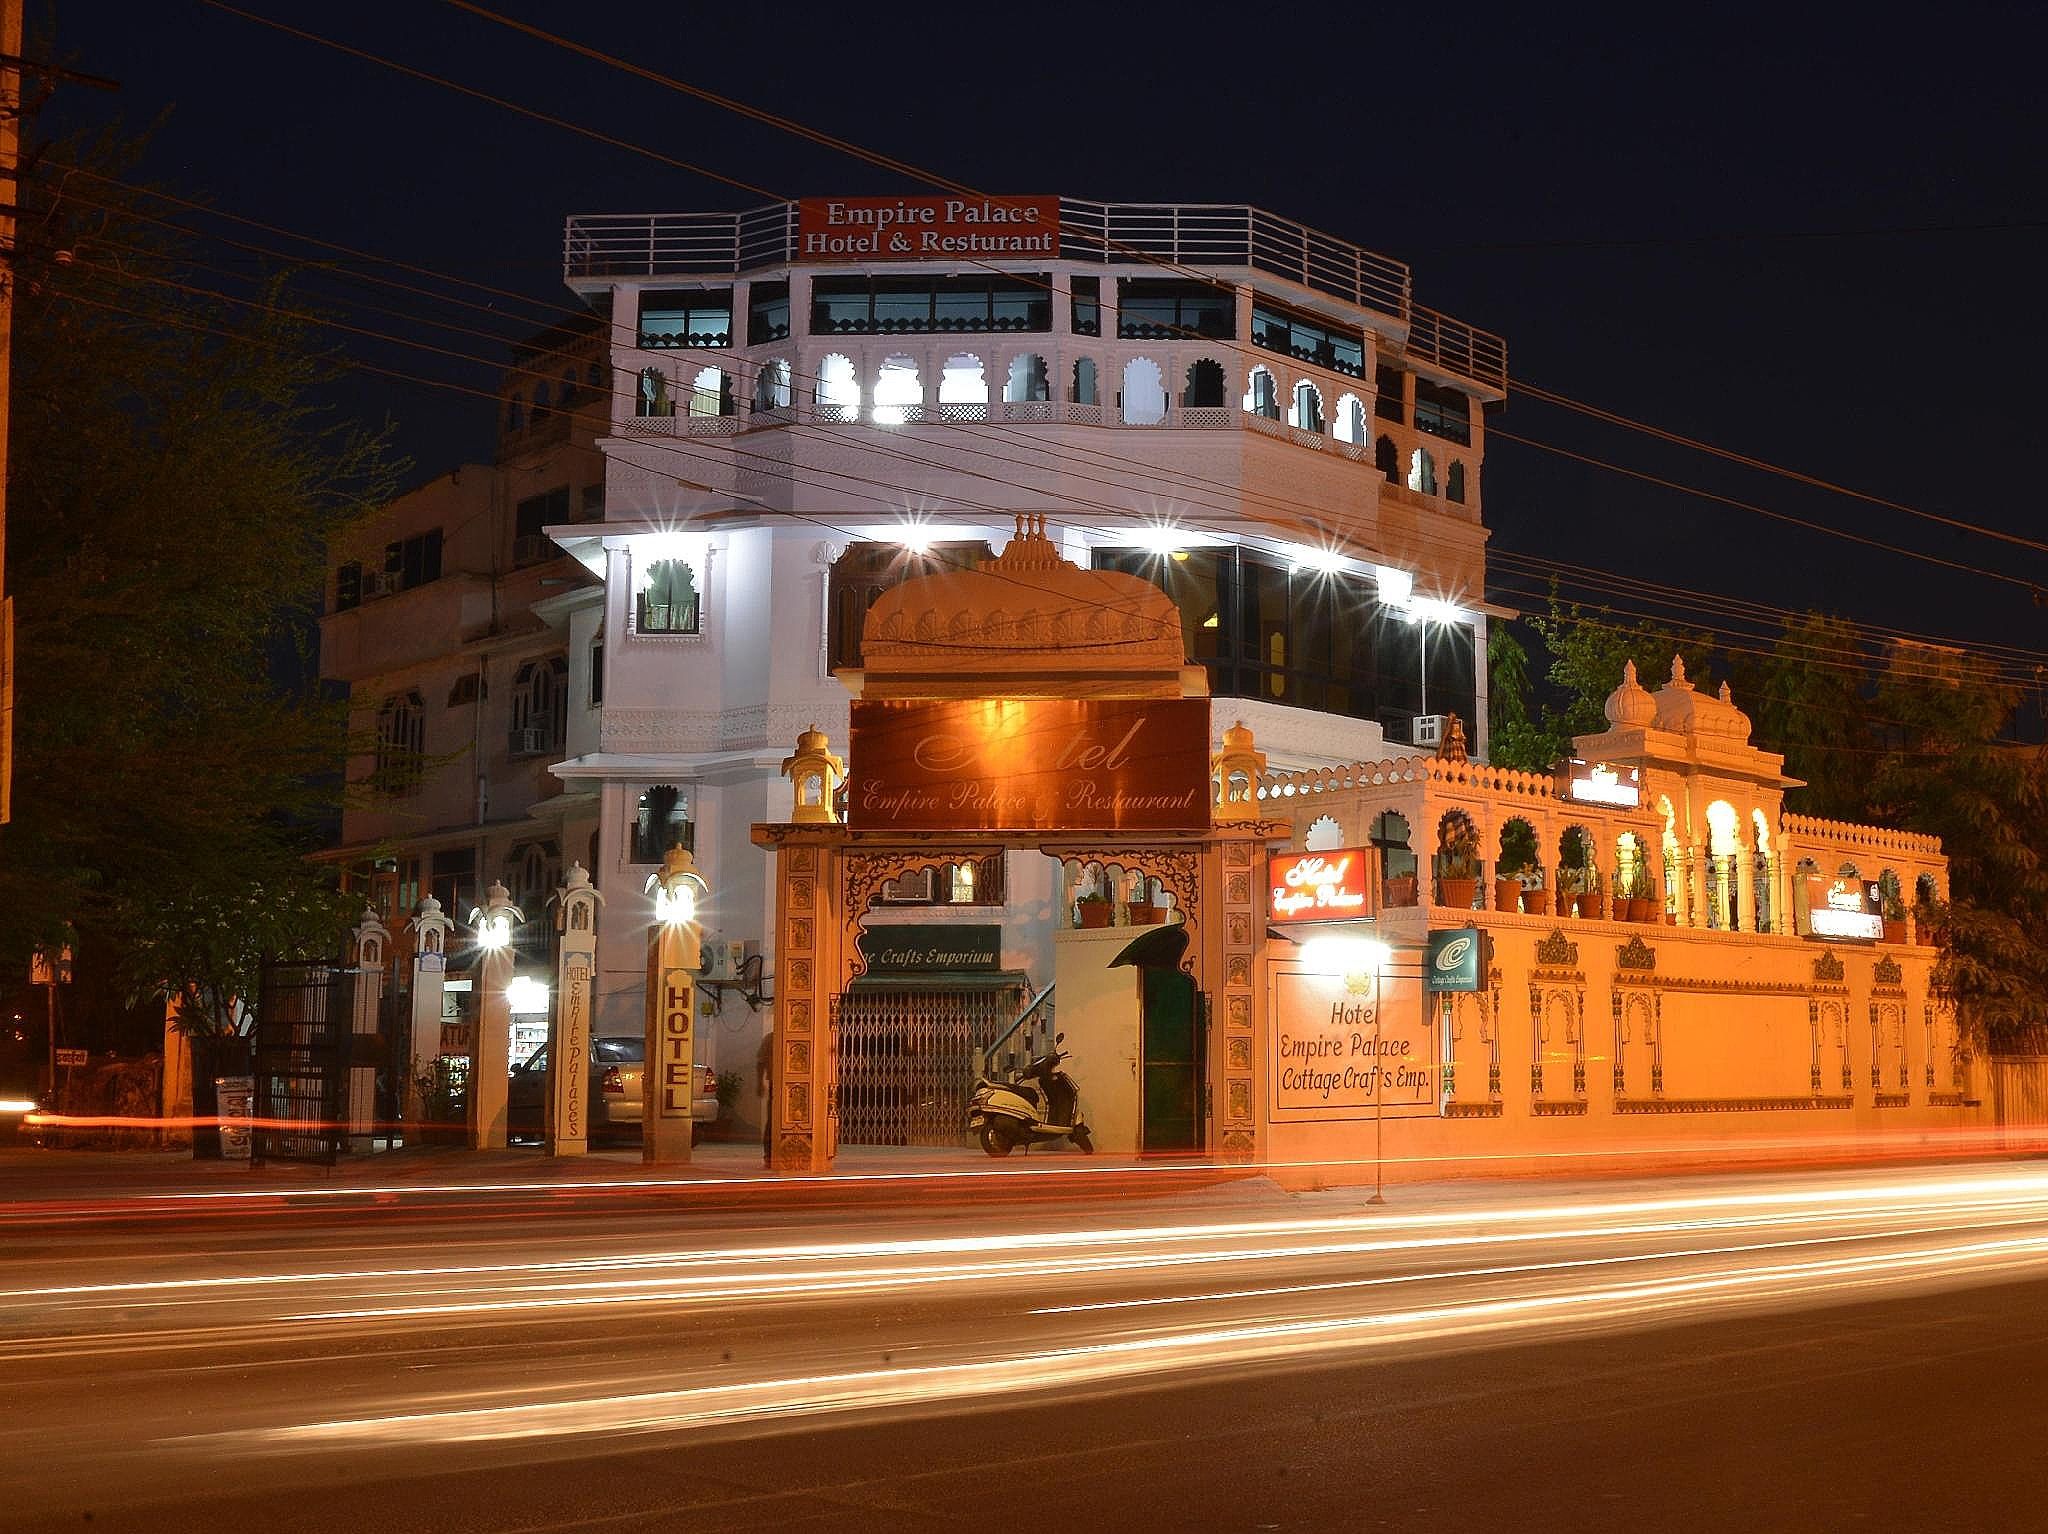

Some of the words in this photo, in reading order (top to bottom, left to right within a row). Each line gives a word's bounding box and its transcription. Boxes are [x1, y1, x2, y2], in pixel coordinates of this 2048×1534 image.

[826, 201, 936, 231] Empire
[944, 199, 1040, 224] Palace
[806, 231, 881, 254] Hotel
[889, 232, 911, 252] &
[919, 230, 1053, 252] Resturant
[862, 779, 939, 820] Empire
[949, 781, 1026, 810] Palace
[1065, 779, 1197, 811] Restaurant
[881, 948, 921, 967] Crafts
[926, 949, 994, 967] Emporium
[567, 967, 590, 981] HOTEL
[1331, 1002, 1379, 1025] Hotel
[666, 987, 690, 1110] HOTEL
[1281, 1034, 1343, 1065] Empire
[1351, 1033, 1411, 1057] Palace
[1282, 1068, 1341, 1098] Cottage
[1396, 1066, 1429, 1098] Emp.
